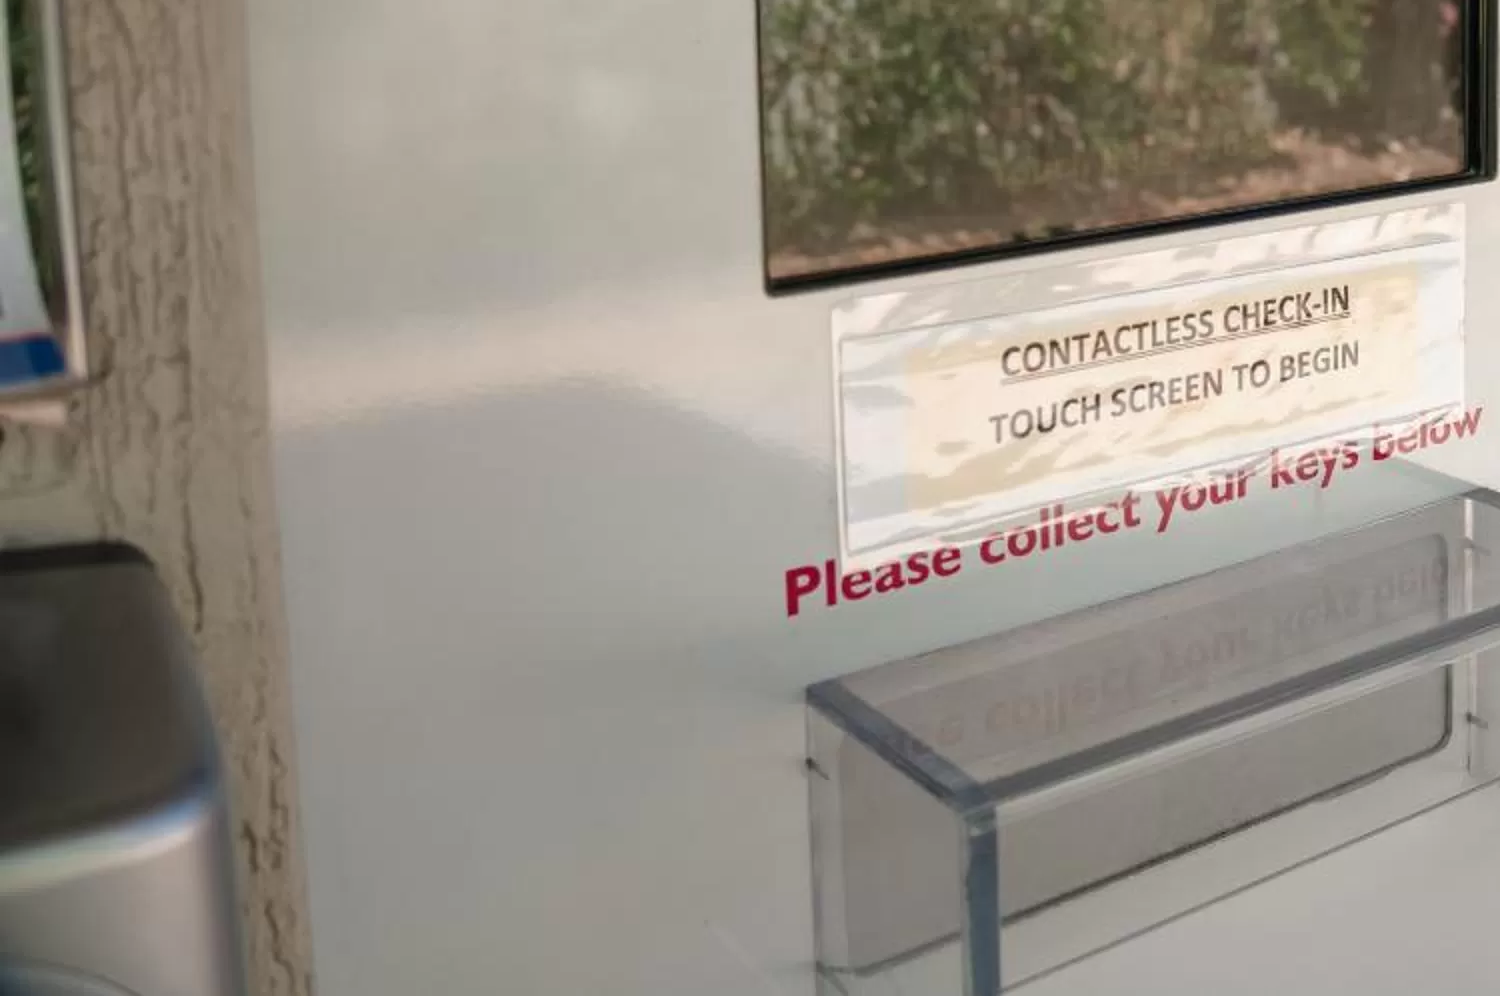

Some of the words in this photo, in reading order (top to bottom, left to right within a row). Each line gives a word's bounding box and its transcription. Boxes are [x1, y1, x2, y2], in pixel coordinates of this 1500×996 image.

[1000, 310, 1215, 377] CONTACTLESS
[1223, 285, 1351, 334] CHECK-IN
[989, 392, 1101, 444] TOUCH
[1110, 368, 1224, 418] SCREEN
[1231, 359, 1271, 392] TO
[1280, 340, 1360, 384] BEGIN
[785, 545, 962, 617] Please
[978, 491, 1142, 566] collect
[1155, 467, 1257, 532] your
[1271, 442, 1360, 489] keys
[1371, 406, 1484, 461] below
